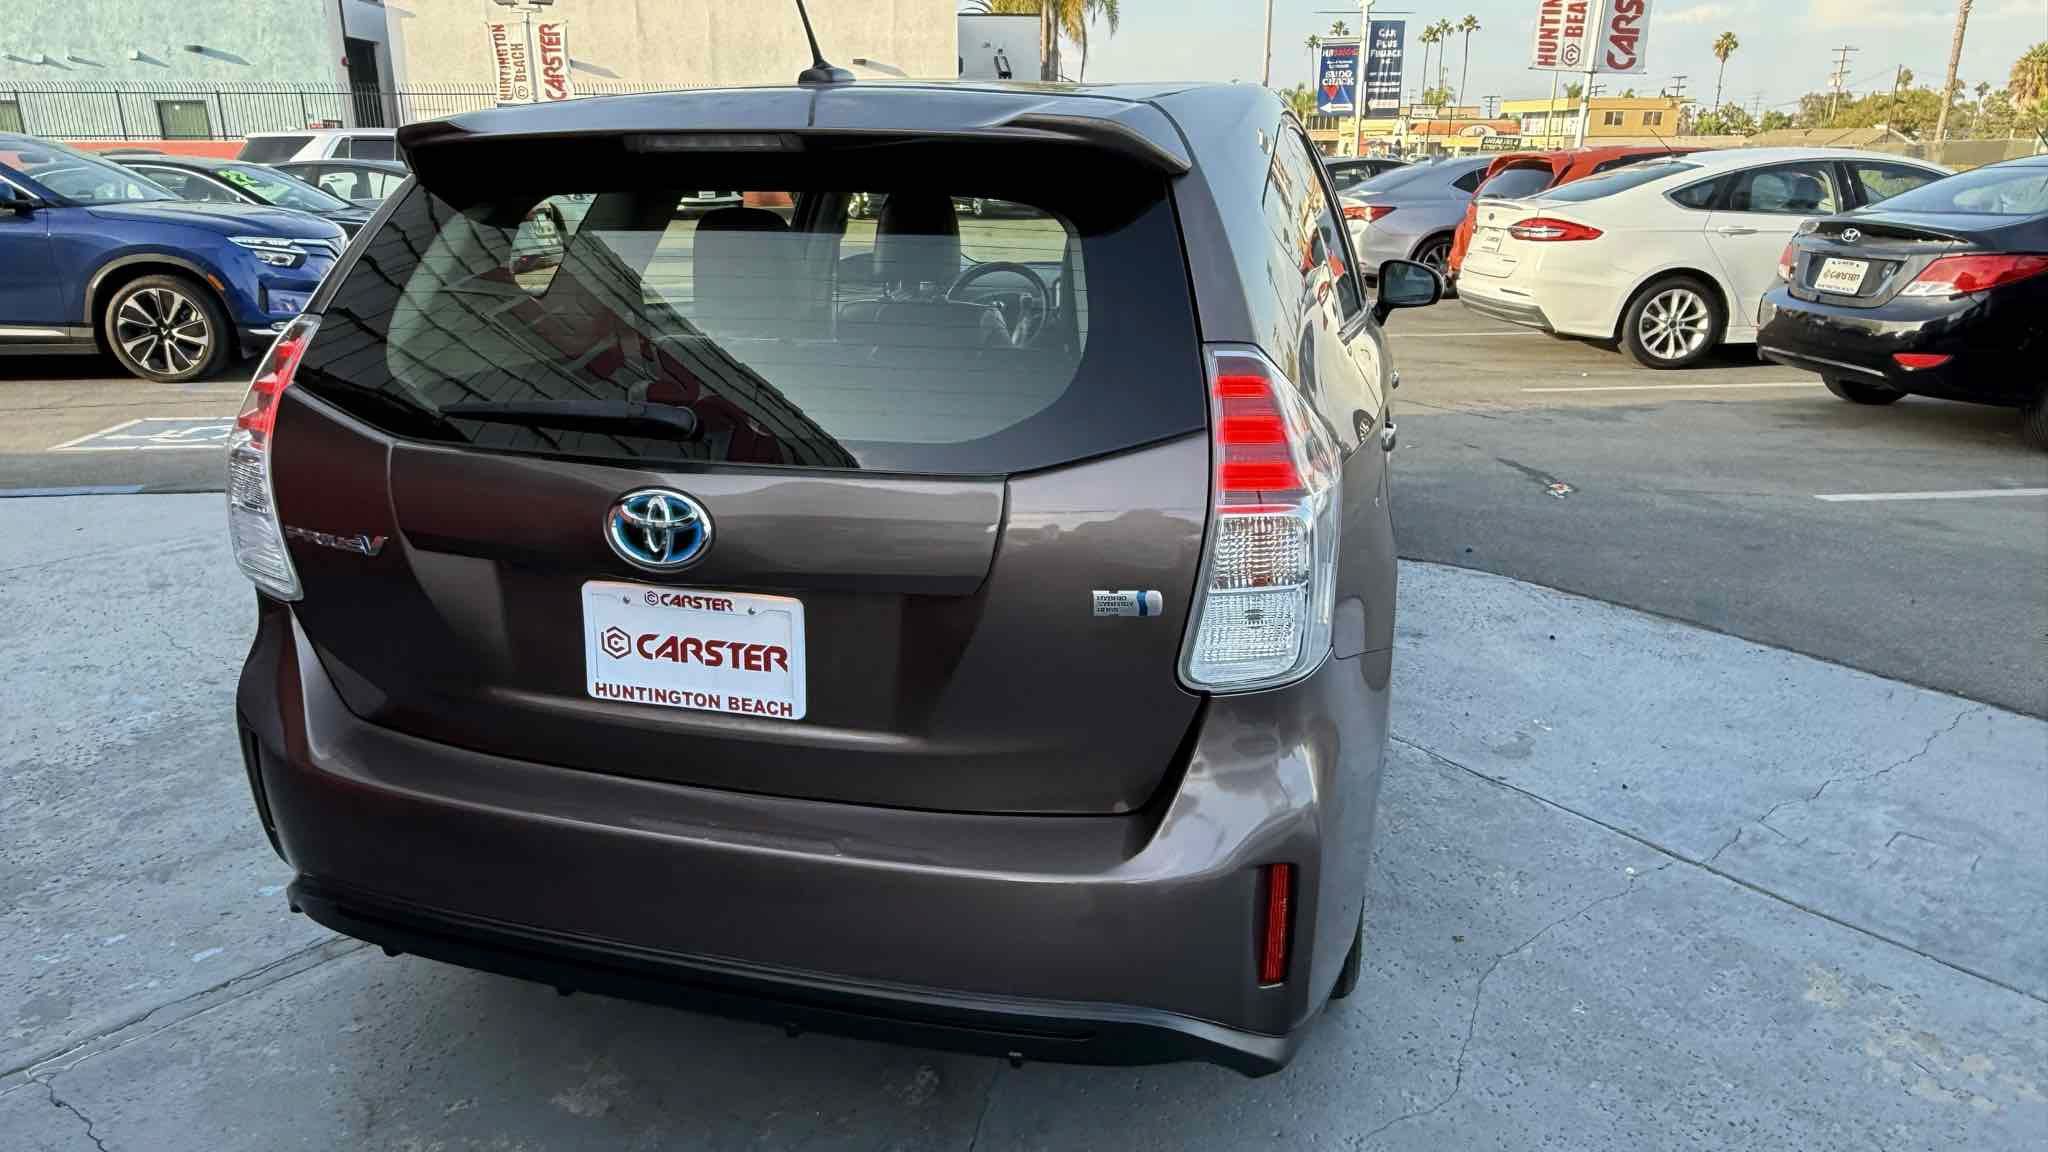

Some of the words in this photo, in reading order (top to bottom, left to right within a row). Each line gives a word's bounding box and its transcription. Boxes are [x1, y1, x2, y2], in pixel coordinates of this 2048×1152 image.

[491, 23, 513, 101] HUNTINGTON
[510, 42, 528, 83] BEACH
[538, 23, 567, 100] CARSTER
[660, 593, 734, 612] CARSTER
[636, 633, 788, 673] CARSTER
[595, 682, 721, 710] HUNTINGTON
[728, 696, 793, 717] BEACH
